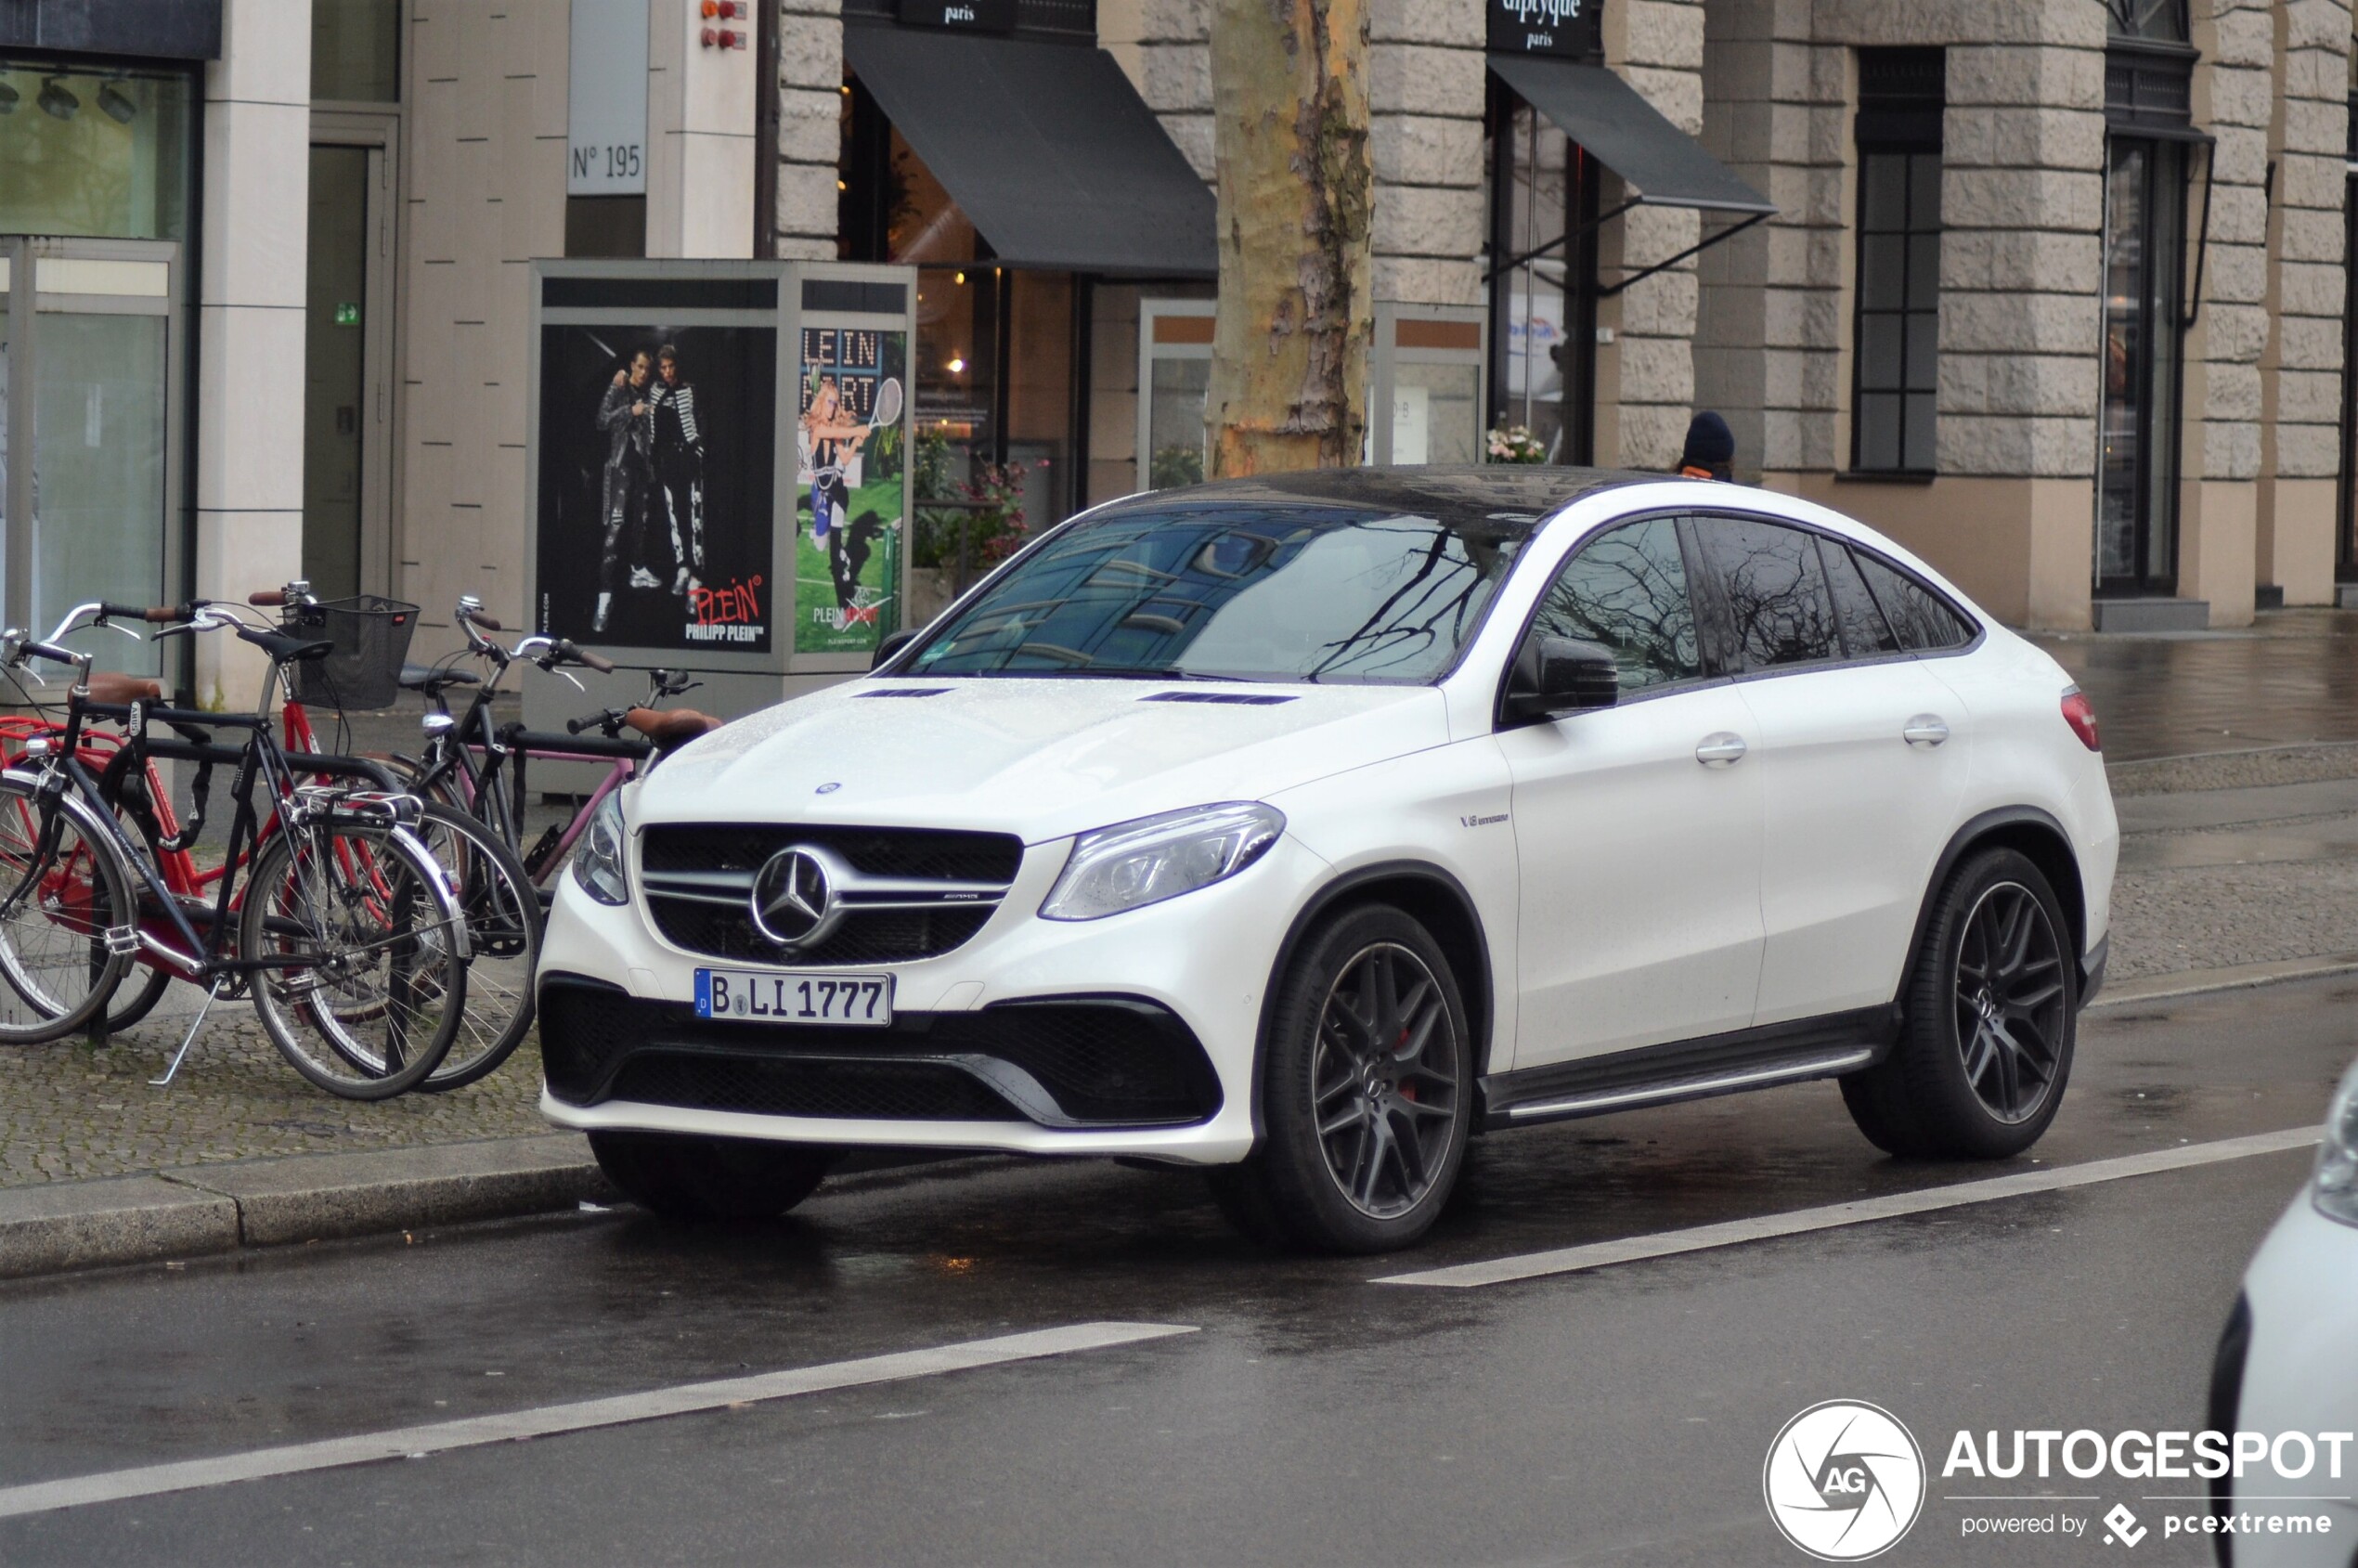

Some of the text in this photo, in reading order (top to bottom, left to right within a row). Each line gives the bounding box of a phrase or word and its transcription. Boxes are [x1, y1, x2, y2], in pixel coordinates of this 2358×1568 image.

[945, 5, 975, 24] paris
[1526, 31, 1553, 50] paris
[606, 145, 640, 177] 195
[685, 623, 726, 641] PHILIPP
[700, 976, 882, 1018] D B LI 1777
